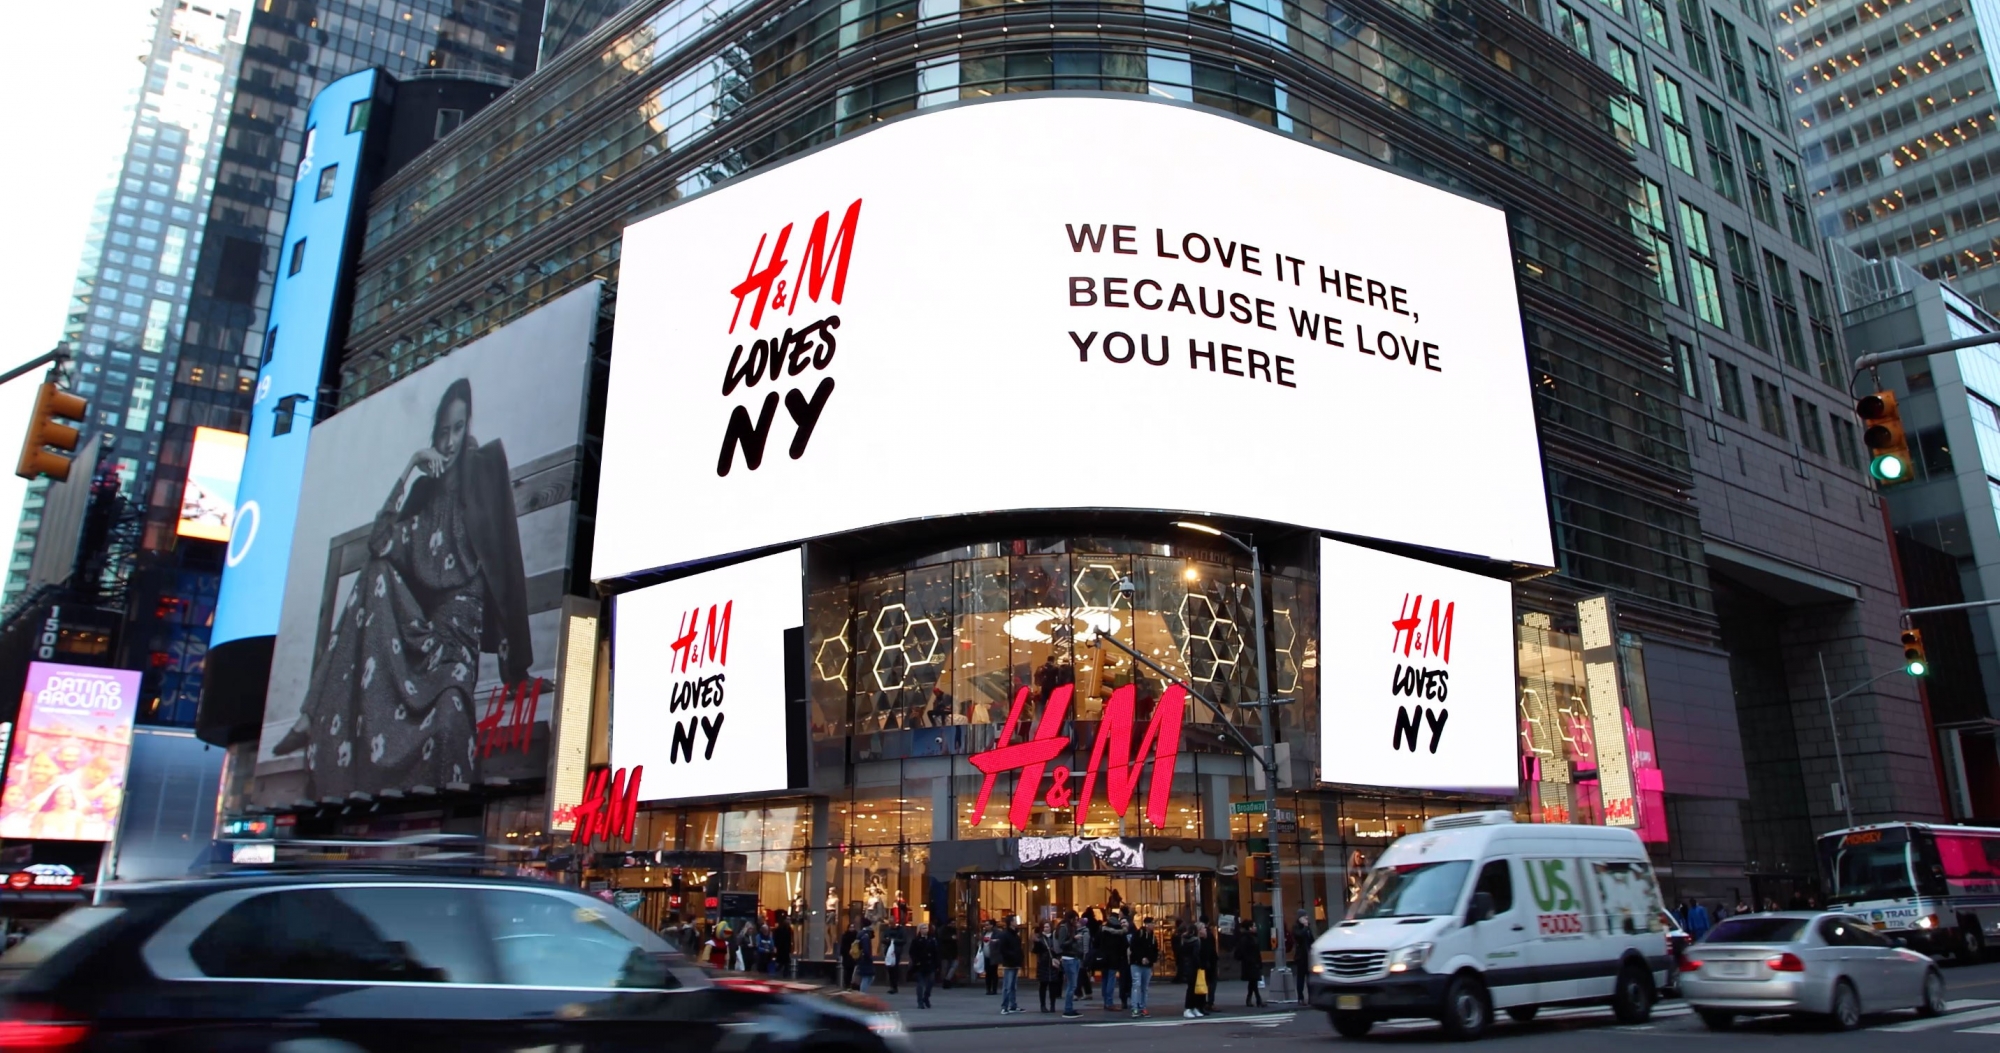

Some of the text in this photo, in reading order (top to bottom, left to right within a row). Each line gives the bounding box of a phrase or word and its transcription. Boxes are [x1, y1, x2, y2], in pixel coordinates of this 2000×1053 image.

[728, 198, 863, 334] H&M
[1065, 223, 1419, 324] WE LOVE IT HERE,
[1068, 276, 1442, 373] BECAUSE WE LOVE
[722, 315, 841, 396] LOVES
[1067, 331, 1296, 389] YOU HERE
[716, 376, 835, 477] NY
[38, 605, 60, 659] 1500
[670, 599, 733, 674] H&M
[1392, 592, 1455, 665] H&M
[37, 689, 122, 710] AROUND
[47, 676, 122, 696] DATING
[669, 673, 725, 713] LOVES
[1392, 663, 1449, 702] LOVES
[670, 712, 725, 764] NY
[967, 680, 1188, 832] H&M
[1393, 704, 1449, 754] NY
[570, 765, 644, 847] H&M
[1237, 803, 1264, 813] Broadway
[1885, 909, 1918, 918] TRAILS
